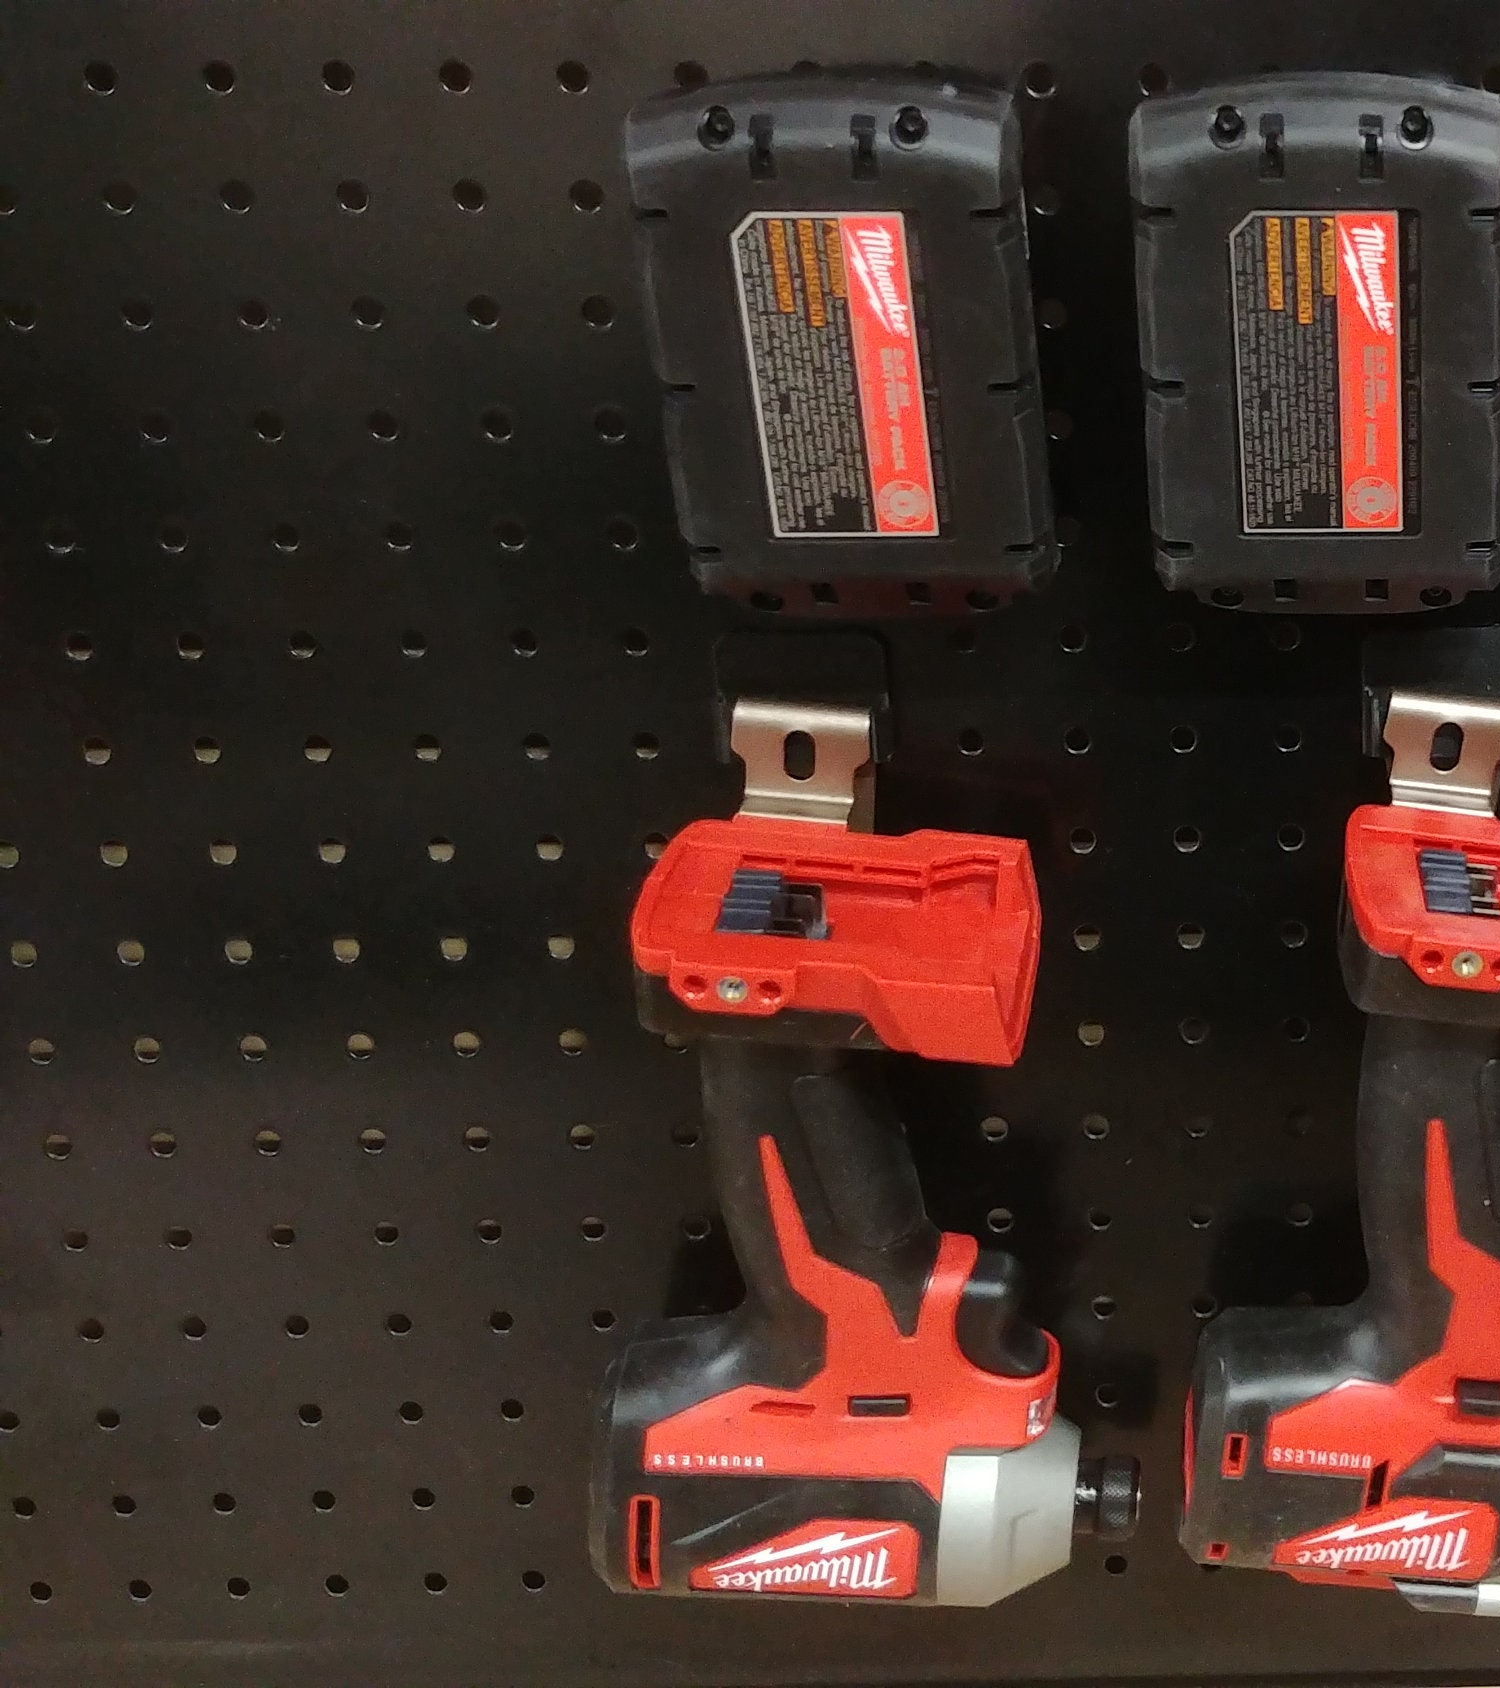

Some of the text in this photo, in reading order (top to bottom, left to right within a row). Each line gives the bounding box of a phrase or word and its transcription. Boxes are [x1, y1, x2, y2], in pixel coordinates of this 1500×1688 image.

[856, 224, 909, 334] Milwaukee
[1350, 222, 1395, 333] Milwaukee
[653, 1453, 764, 1468] BRUSHLESS
[1271, 1446, 1372, 1469] BRUSHLESS
[713, 1545, 897, 1592] Milwaukee
[1296, 1527, 1469, 1572] Milwaukee
